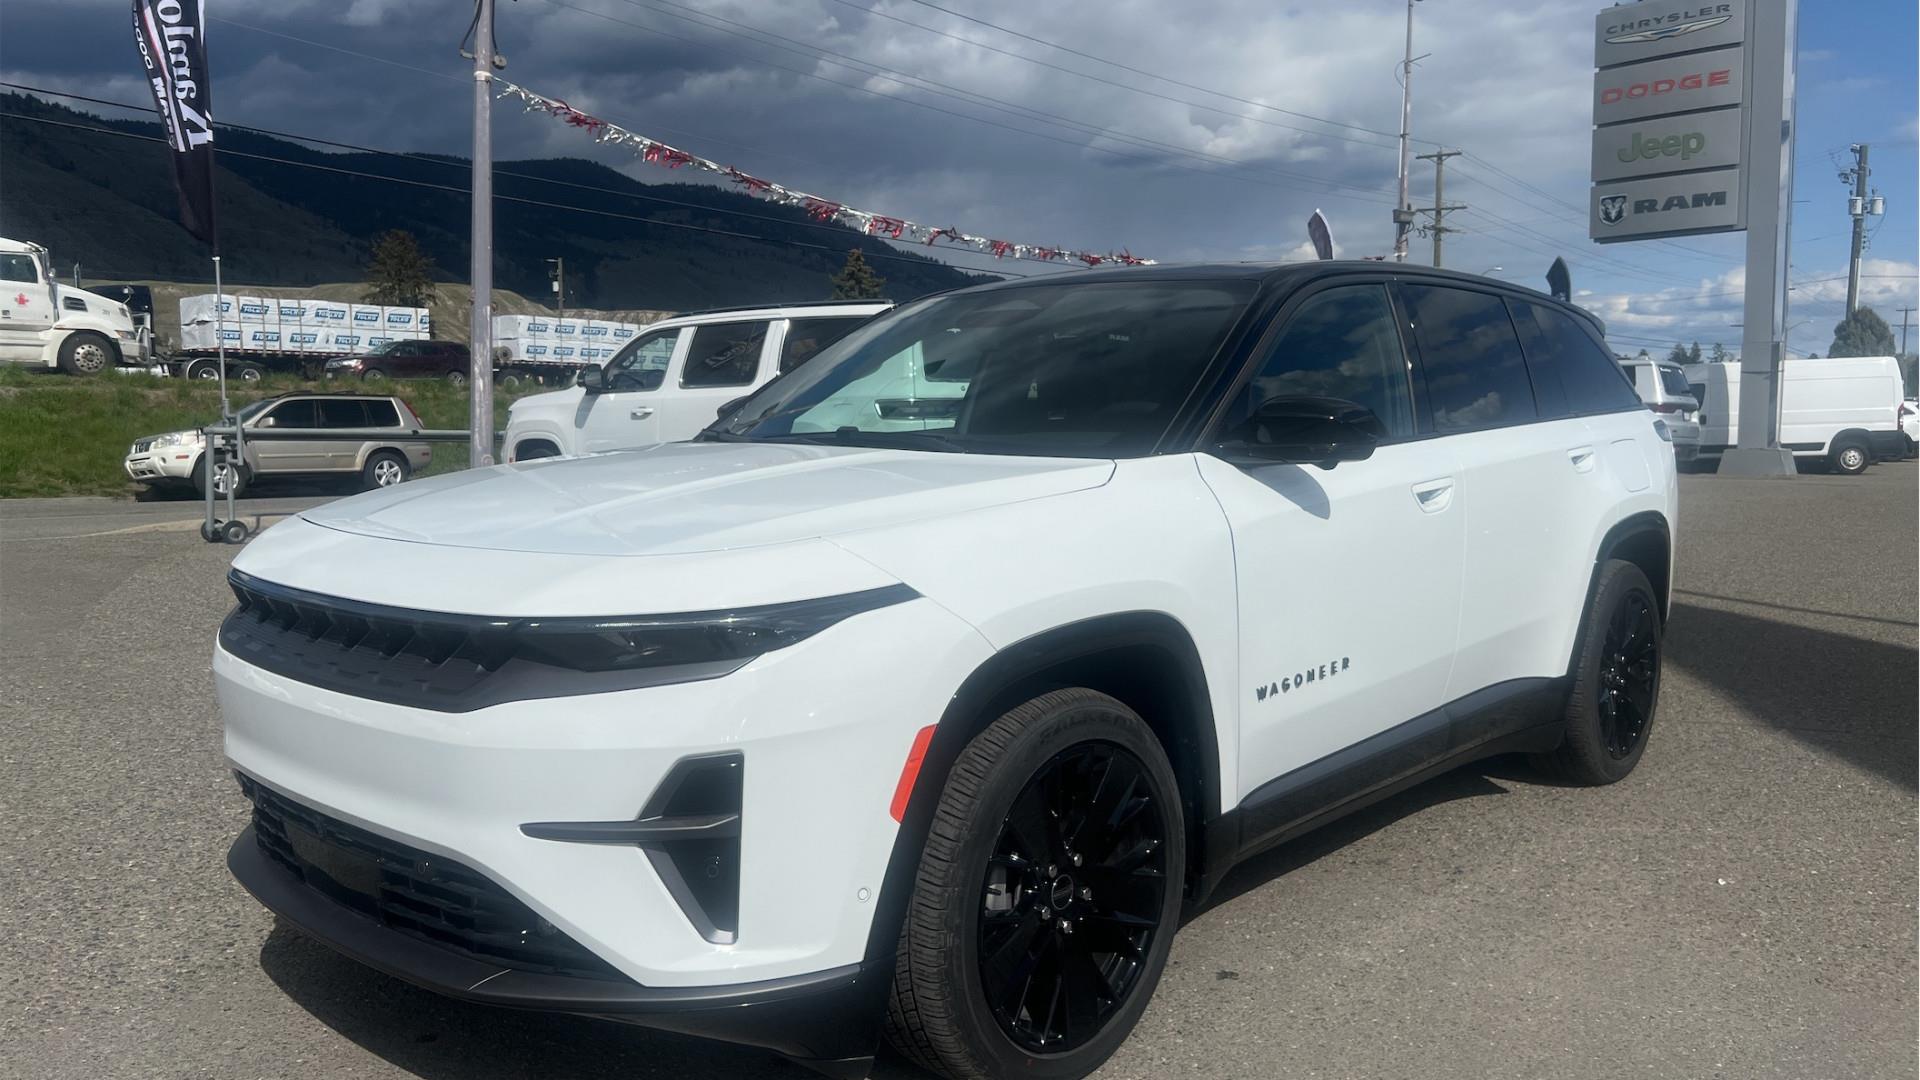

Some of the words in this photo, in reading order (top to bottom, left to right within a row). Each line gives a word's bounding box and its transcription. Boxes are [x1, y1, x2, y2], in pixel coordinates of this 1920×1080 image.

[1606, 4, 1731, 34] CHRYSLER
[1601, 69, 1730, 105] DODGE
[1617, 132, 1705, 163] Jeep
[1633, 191, 1727, 215] RAM
[1256, 656, 1350, 703] WAGONEER
